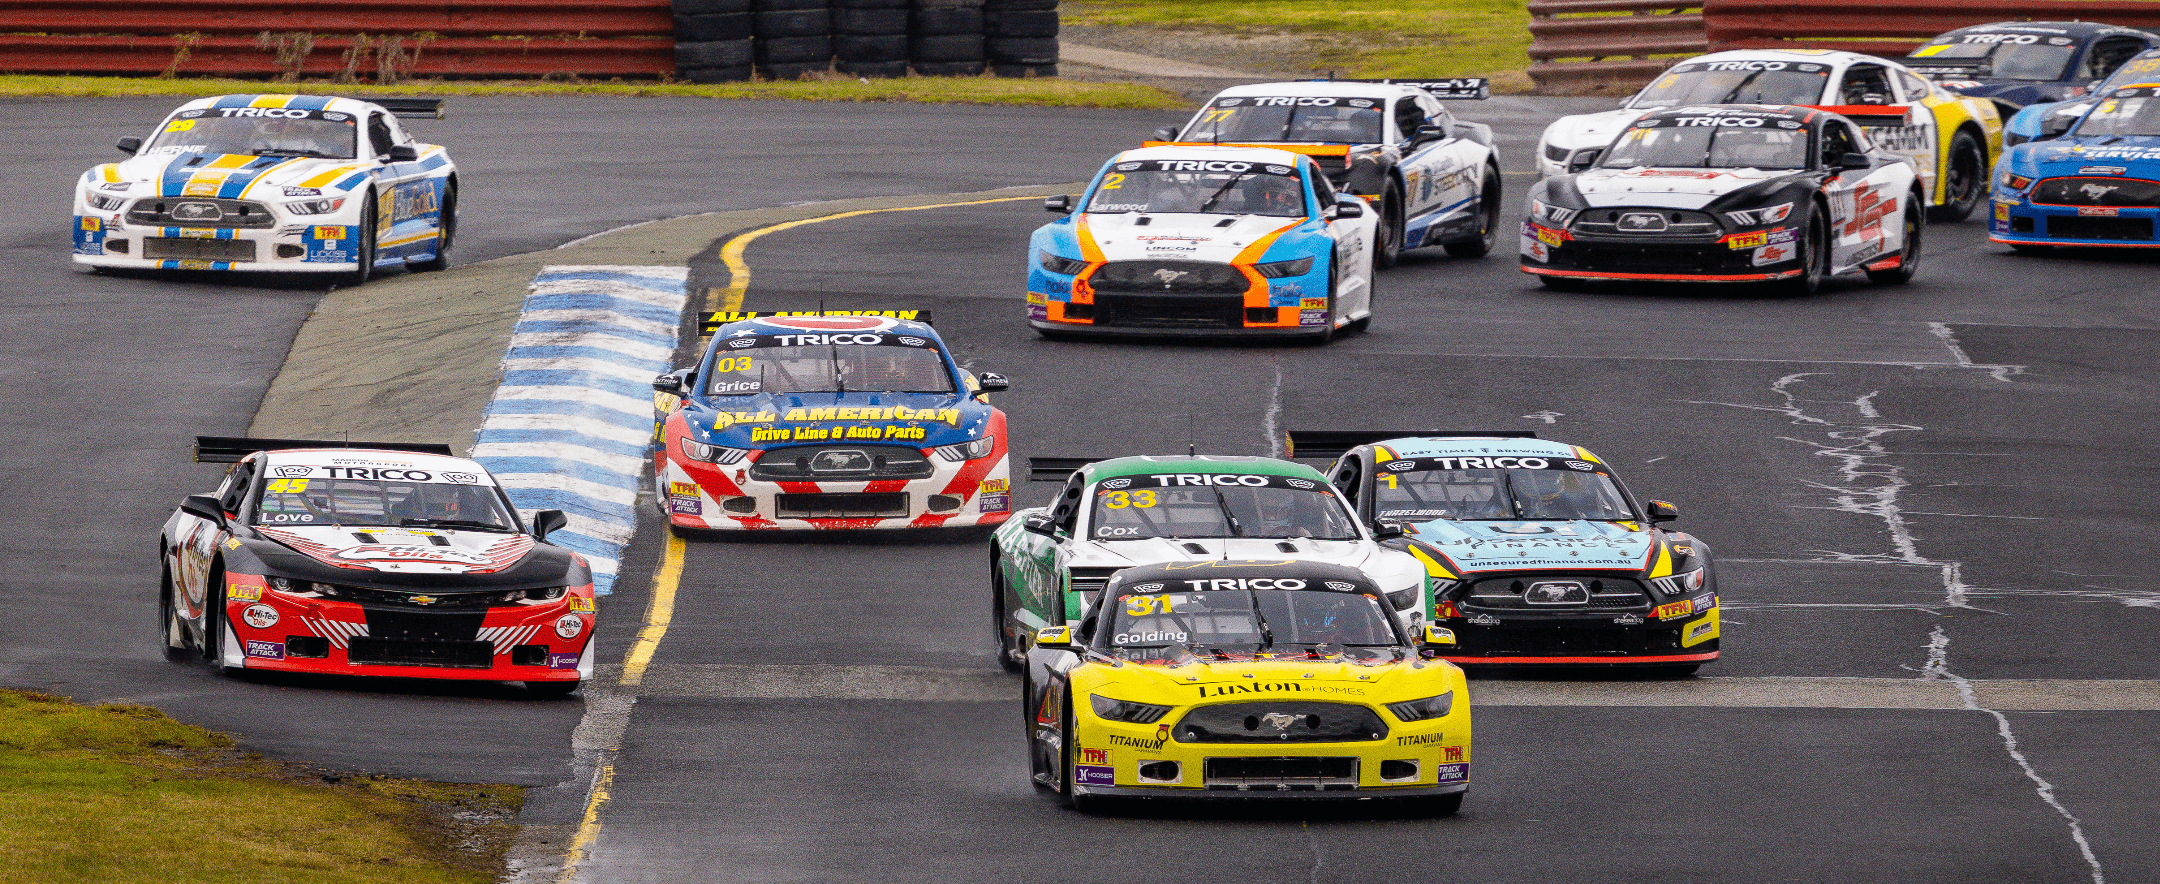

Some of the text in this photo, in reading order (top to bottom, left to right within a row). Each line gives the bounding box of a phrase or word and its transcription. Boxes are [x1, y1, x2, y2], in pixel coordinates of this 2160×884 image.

[1963, 34, 2039, 44] TRICO
[1707, 61, 1788, 71] TRICO
[1255, 97, 1337, 107] TRICO
[220, 107, 309, 119] TRICO
[166, 119, 196, 132] 29
[1675, 117, 1765, 128] TRICO
[1157, 160, 1253, 173] TRICO
[1102, 173, 1125, 190] 2
[709, 311, 757, 322] ALL
[774, 334, 881, 346] TRICO
[718, 357, 752, 373] 03
[714, 381, 760, 392] Grice
[713, 406, 961, 430] ALL AMERICAN
[752, 427, 790, 442] Drive
[794, 427, 829, 440] Line
[846, 425, 881, 439] Auto
[885, 425, 925, 439] Parts
[1434, 457, 1549, 469] TRICO
[322, 466, 432, 481] TRICO
[267, 479, 310, 493] 45
[1151, 474, 1269, 487] TRICO
[1386, 474, 1397, 489] 1
[675, 482, 696, 494] TFH
[672, 498, 696, 507] TRACK
[1106, 489, 1157, 509] 33
[675, 505, 699, 513] ATTACK
[262, 512, 314, 522] Love
[1097, 526, 1139, 537] Cox
[1470, 558, 1632, 567] unsecuredfinance.com.au
[234, 584, 257, 597] TFH
[1185, 578, 1306, 592] TRICO
[1126, 594, 1173, 617] 31
[1662, 604, 1688, 616] TFH
[254, 608, 278, 620] Hi-Tec
[254, 618, 267, 626] Oils
[1115, 631, 1188, 645] Golding
[248, 642, 275, 651] TRACK
[250, 649, 279, 657] ATTACK
[1200, 682, 1365, 698] Luxton HOMES
[1109, 735, 1164, 750] TITANIUM
[1397, 733, 1443, 746] TITANIUM
[1084, 749, 1105, 762] TFH
[1445, 747, 1461, 761] TFH
[1441, 772, 1463, 780] ATTACK
